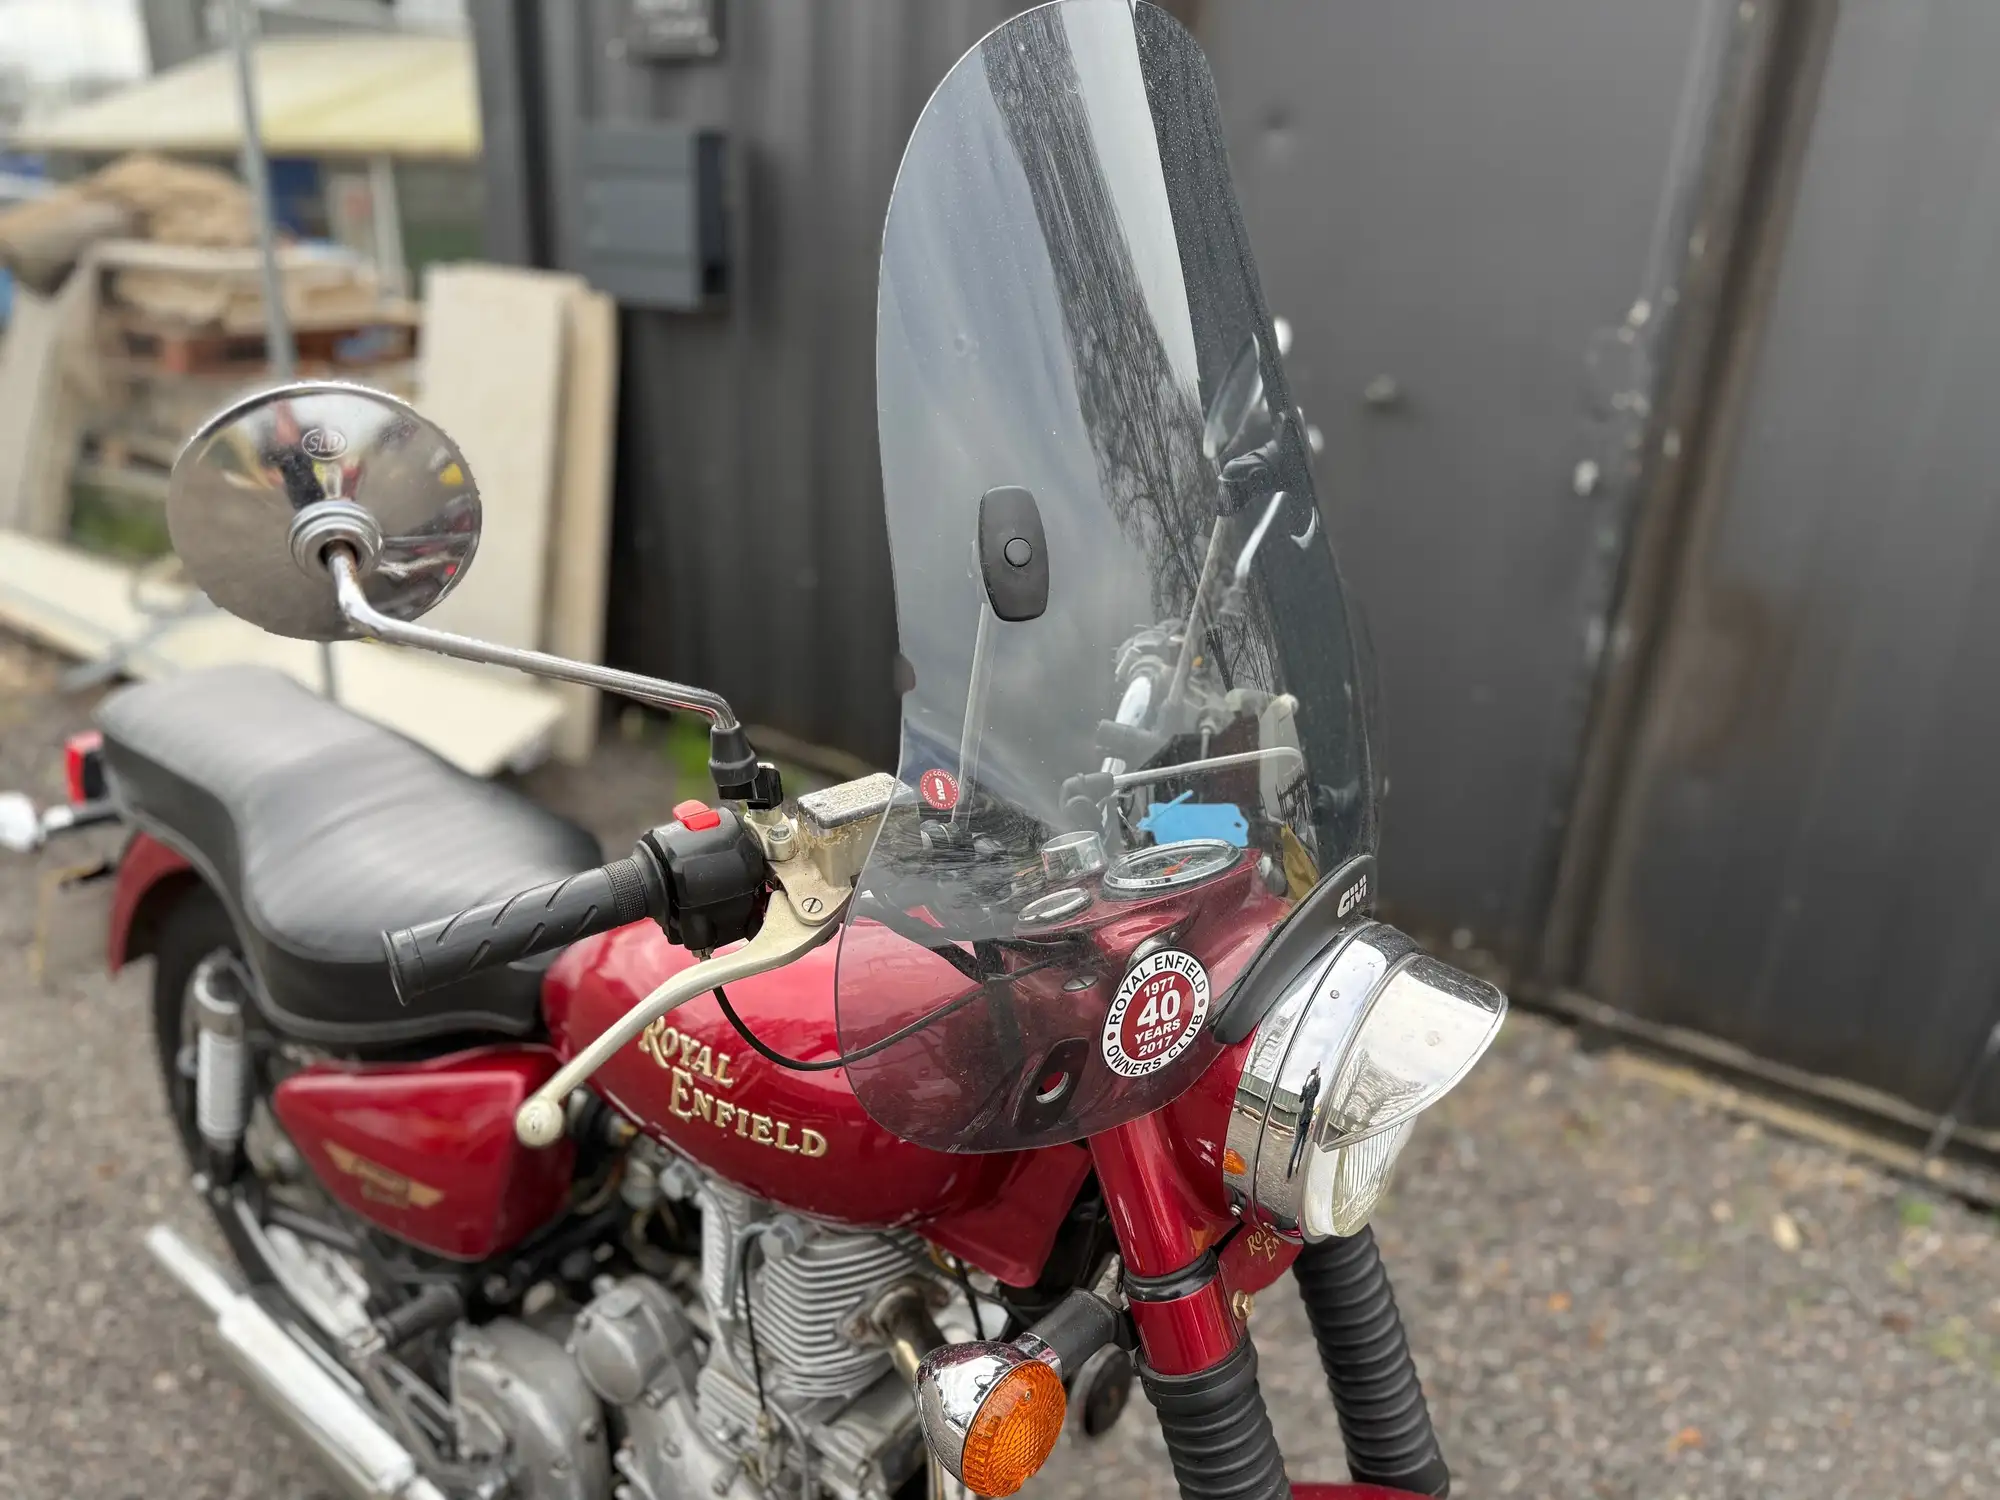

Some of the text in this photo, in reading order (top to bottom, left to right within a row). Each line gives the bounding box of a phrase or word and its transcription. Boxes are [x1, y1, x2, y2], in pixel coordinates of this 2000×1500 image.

[923, 790, 944, 808] QUALITY
[933, 770, 957, 789] CONTROL
[1337, 874, 1367, 918] GIVI
[1109, 954, 1206, 1025] ROYAL ENFIELD
[1143, 975, 1176, 997] 1977
[1136, 989, 1181, 1028] 40
[1106, 1014, 1204, 1075] OWNERS CLUB
[1134, 1018, 1181, 1045] YEARS
[1137, 1035, 1174, 1058] 2017
[638, 1015, 735, 1089] ROYAL
[668, 1066, 828, 1158] ENFIELD
